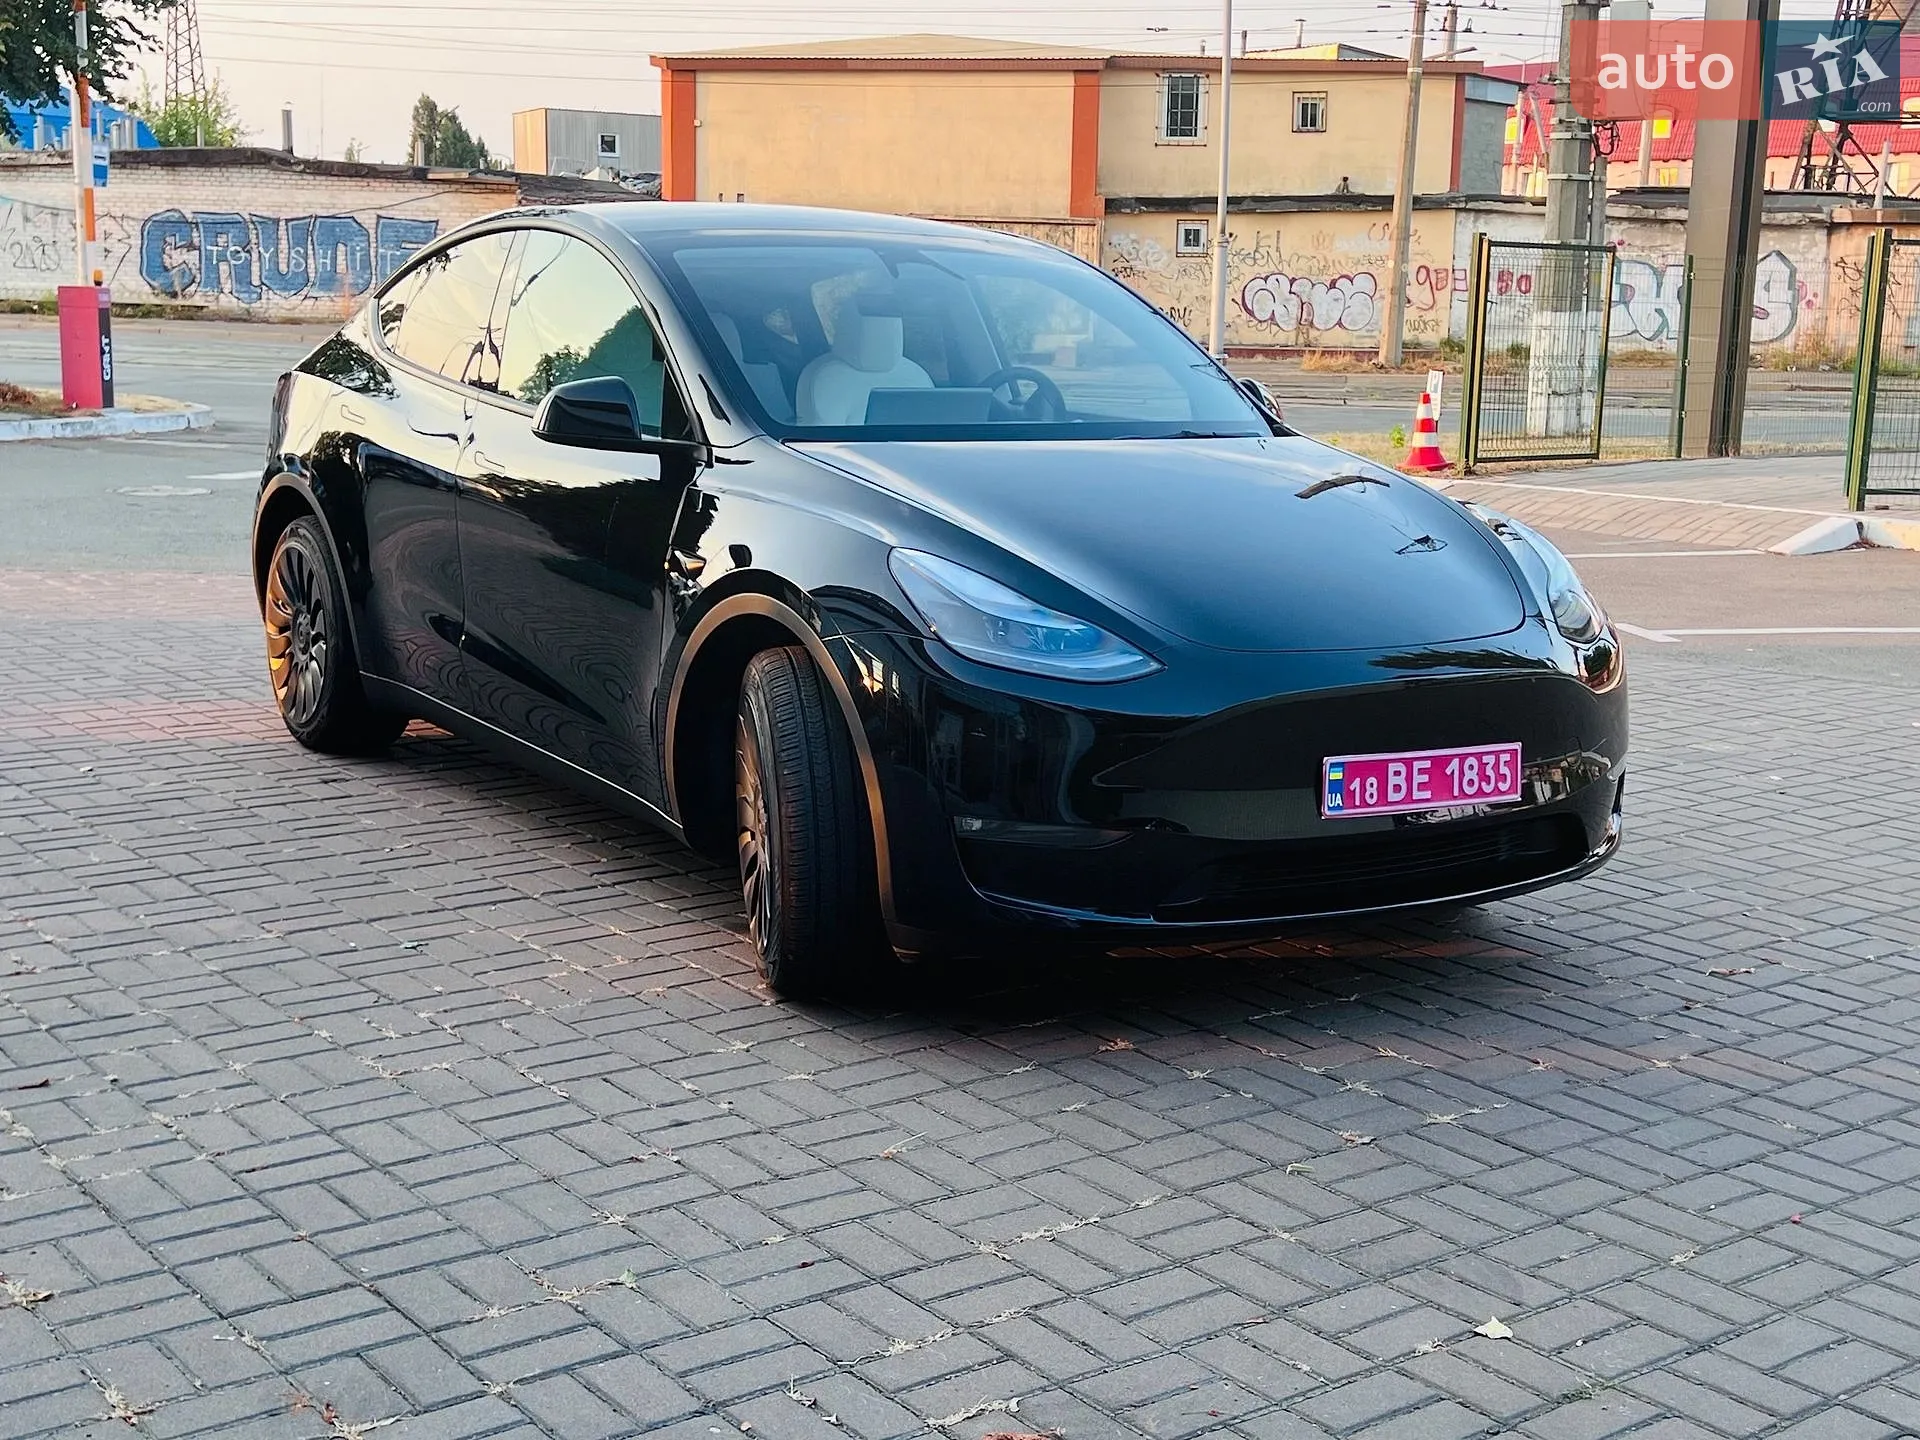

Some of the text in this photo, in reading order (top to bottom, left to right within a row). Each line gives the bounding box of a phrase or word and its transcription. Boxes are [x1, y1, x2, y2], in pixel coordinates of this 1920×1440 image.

[1349, 753, 1512, 806] 18 BE 1835
[1328, 793, 1343, 808] UA
